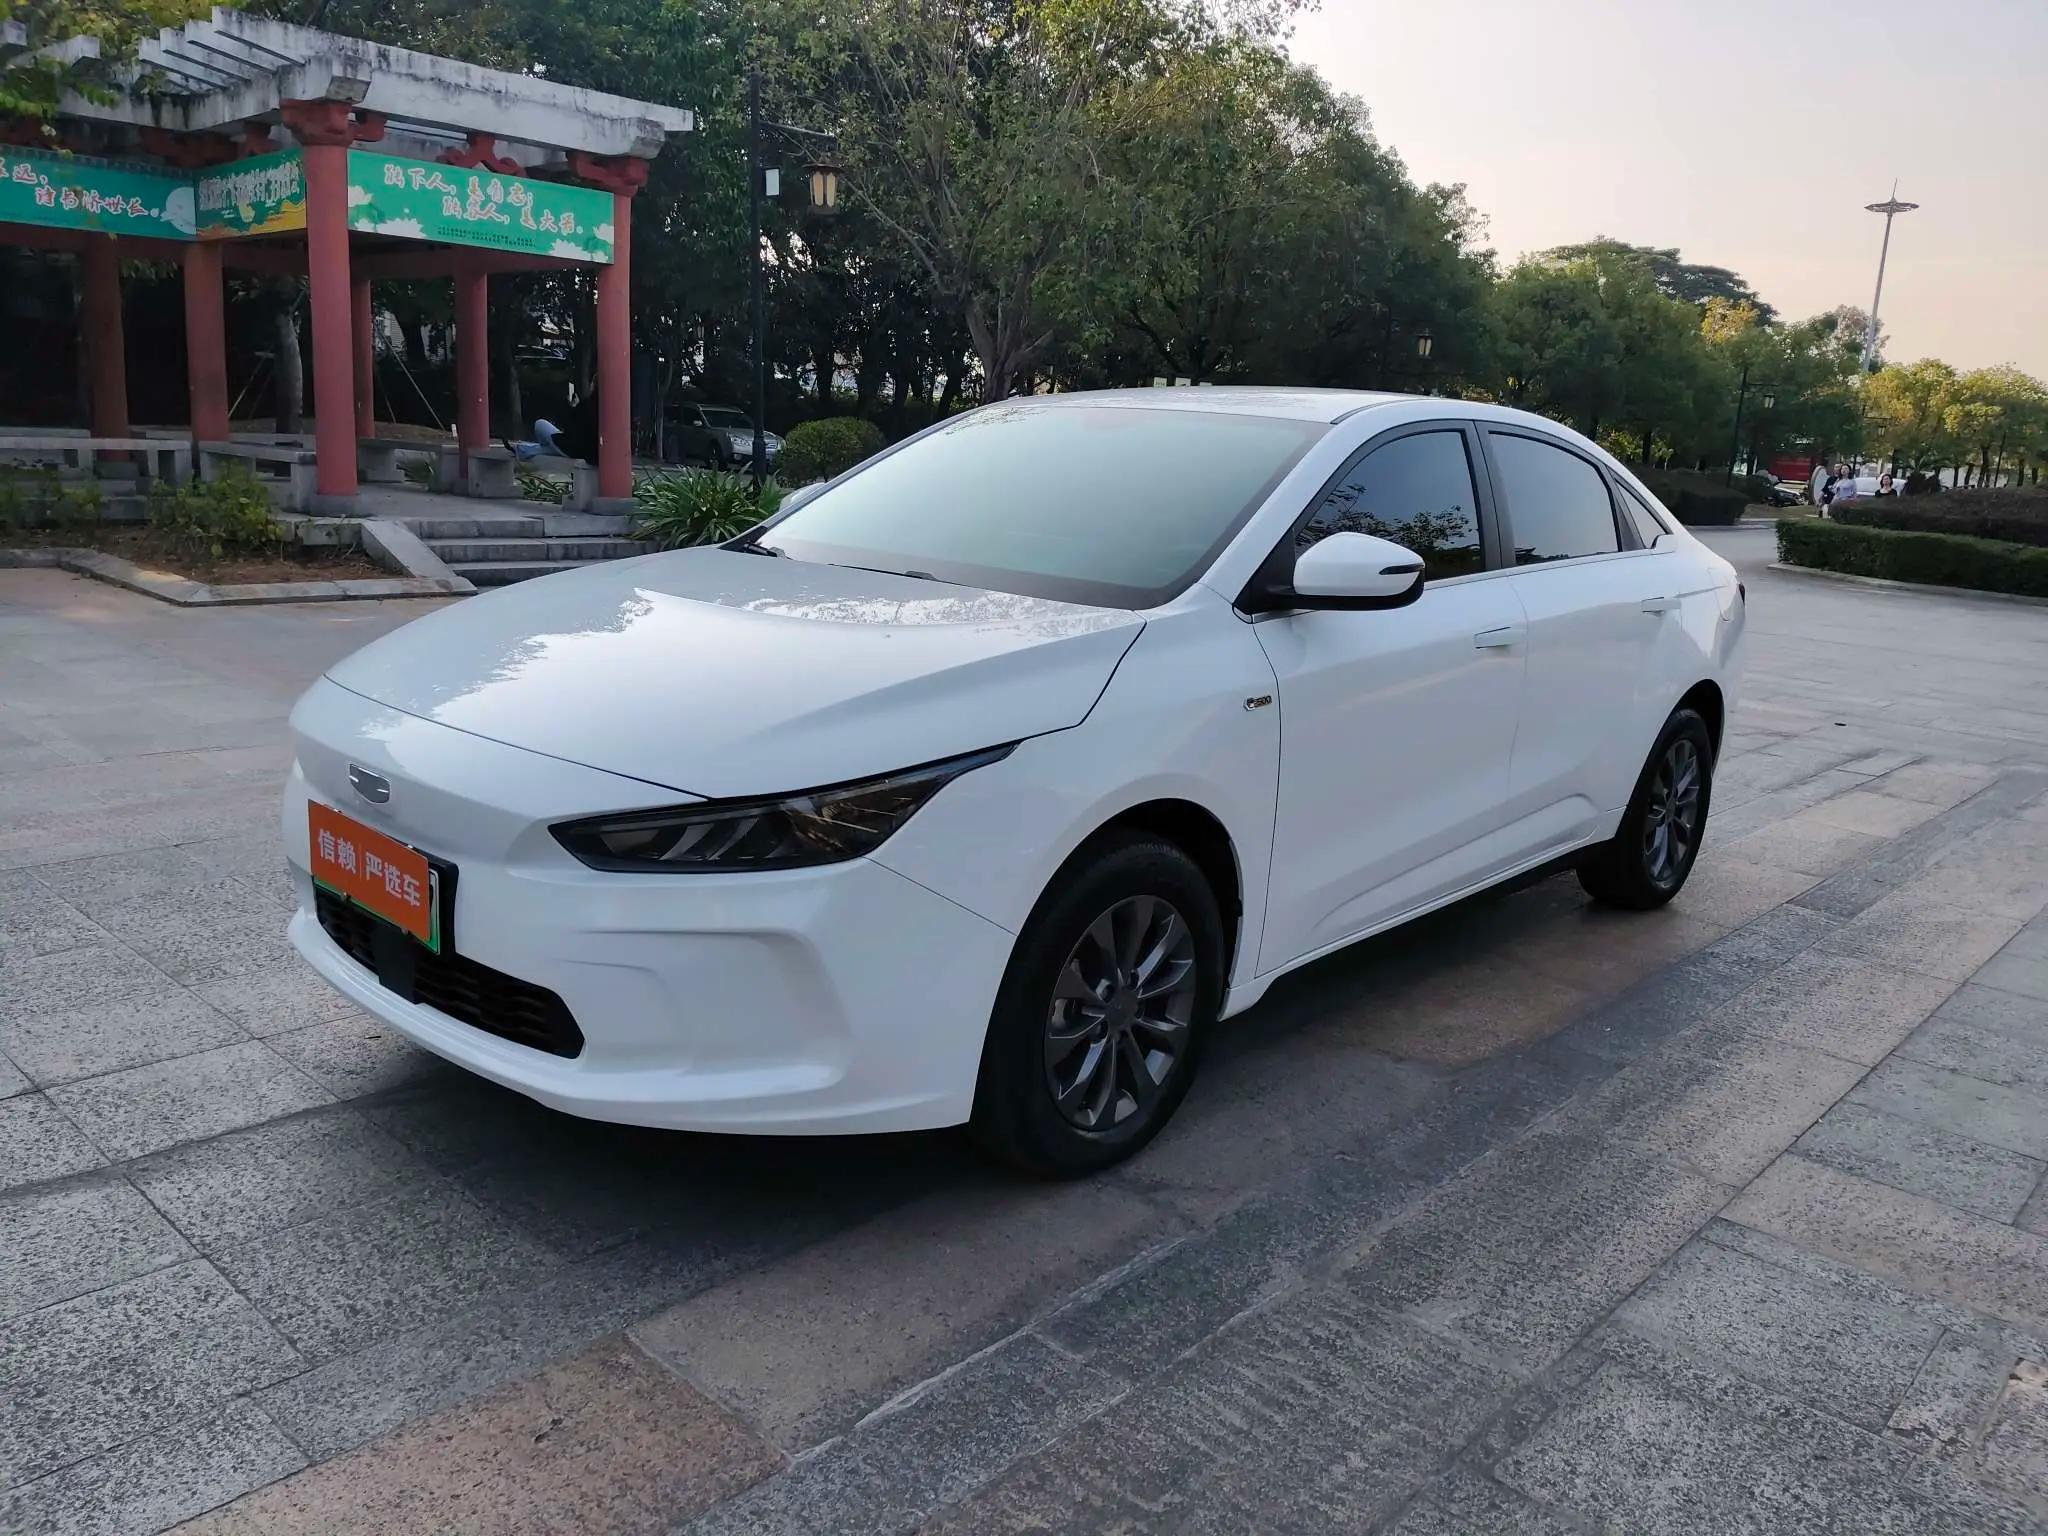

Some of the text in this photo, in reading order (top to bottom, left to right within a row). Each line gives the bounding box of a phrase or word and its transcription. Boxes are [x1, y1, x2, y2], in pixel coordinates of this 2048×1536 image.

[318, 829, 421, 907] 信赖 严选车
